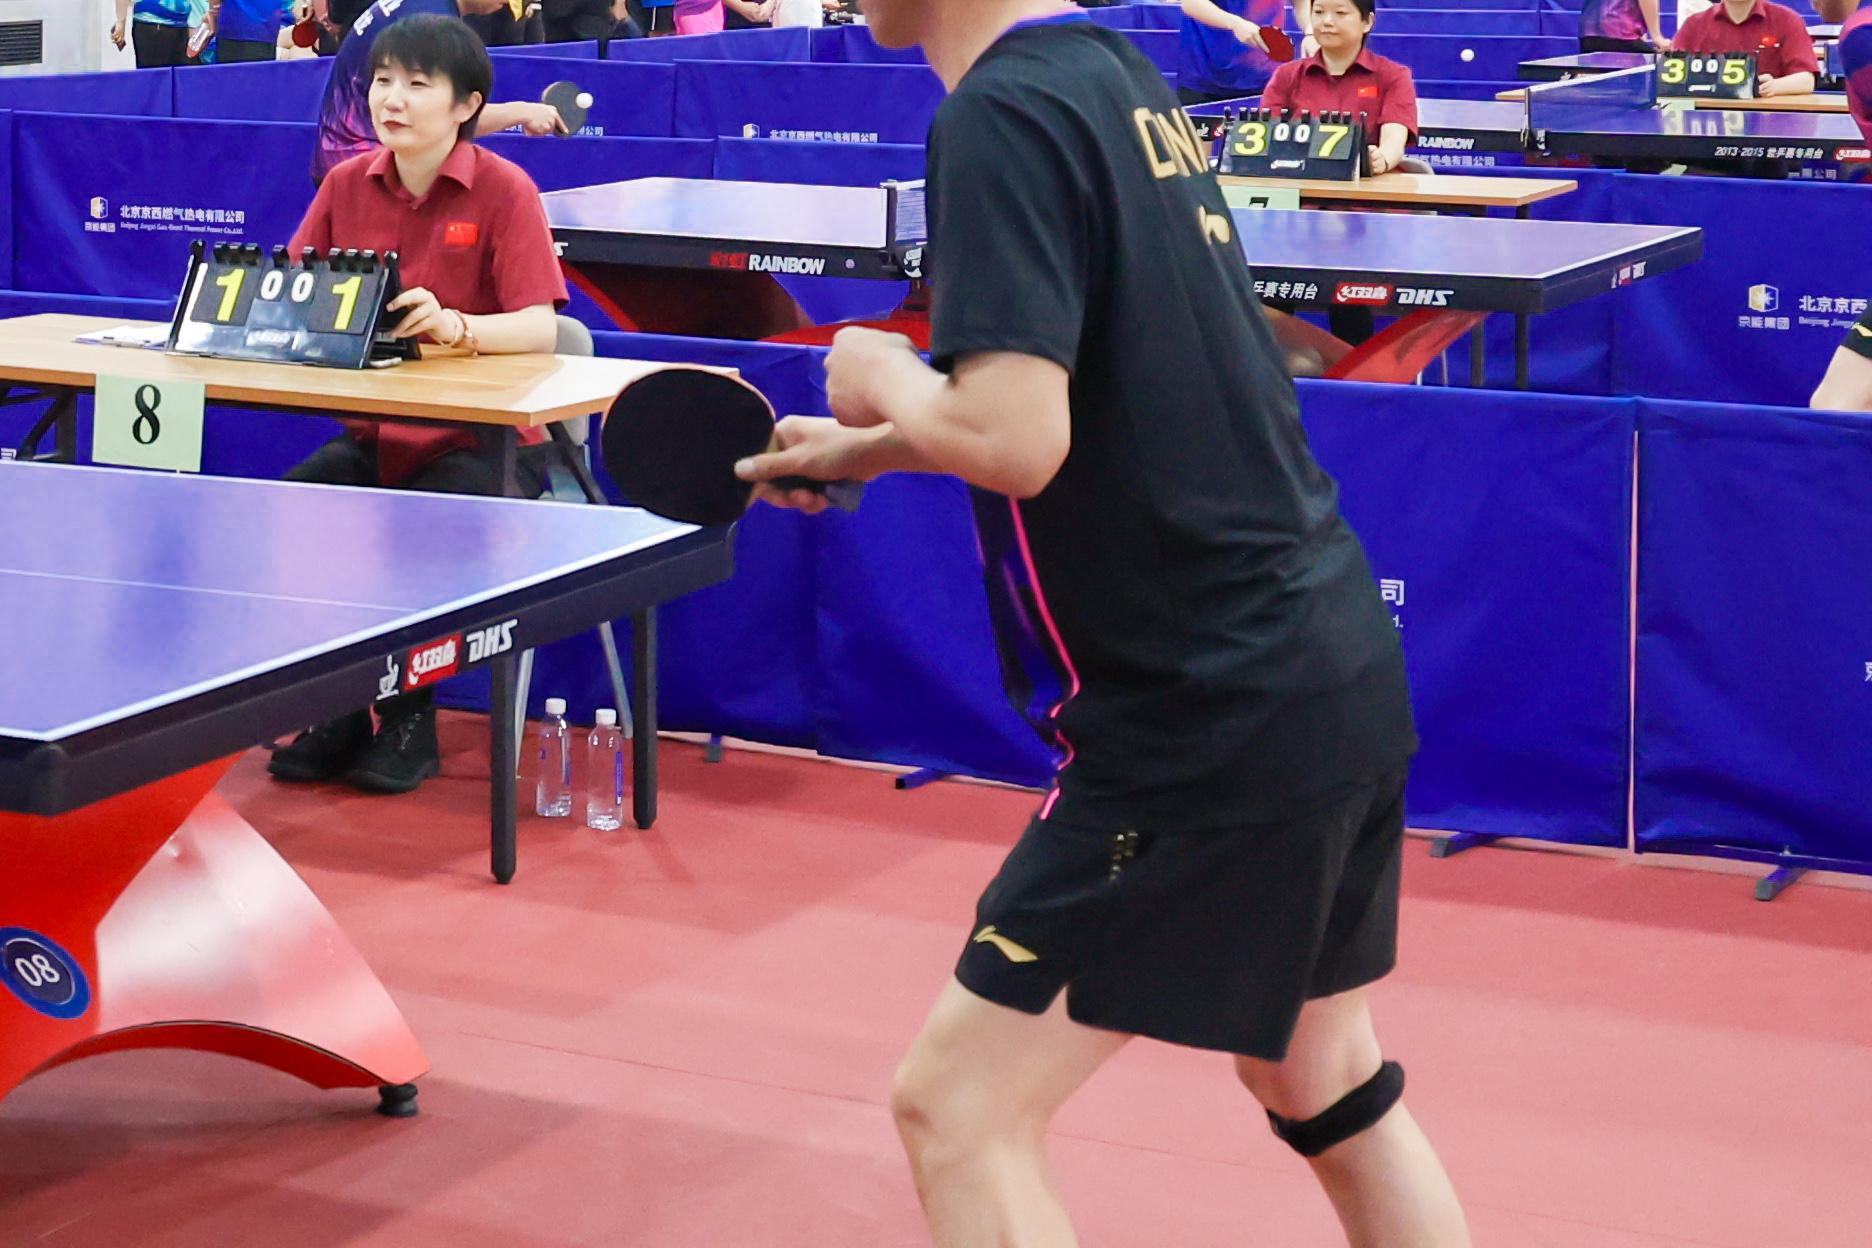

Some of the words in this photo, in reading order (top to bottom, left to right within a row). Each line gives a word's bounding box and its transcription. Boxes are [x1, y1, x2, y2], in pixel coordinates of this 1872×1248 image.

[1661, 58, 1685, 84] 3
[1690, 58, 1703, 73] 0
[1706, 58, 1719, 73] 0
[1722, 58, 1746, 85] 5
[1234, 122, 1266, 155] 3
[1274, 122, 1290, 141] 0
[1295, 124, 1310, 143] 0
[1318, 125, 1350, 157] 7
[1418, 136, 1475, 150] RAINBOW
[749, 254, 826, 275] RAINBOW
[216, 268, 246, 322] 1
[260, 270, 284, 300] 0
[291, 272, 315, 302] 0
[332, 276, 362, 330] 1
[1396, 288, 1455, 306] DHS
[132, 383, 162, 445] 8
[466, 618, 519, 663] DHS
[15, 954, 60, 986] 08
